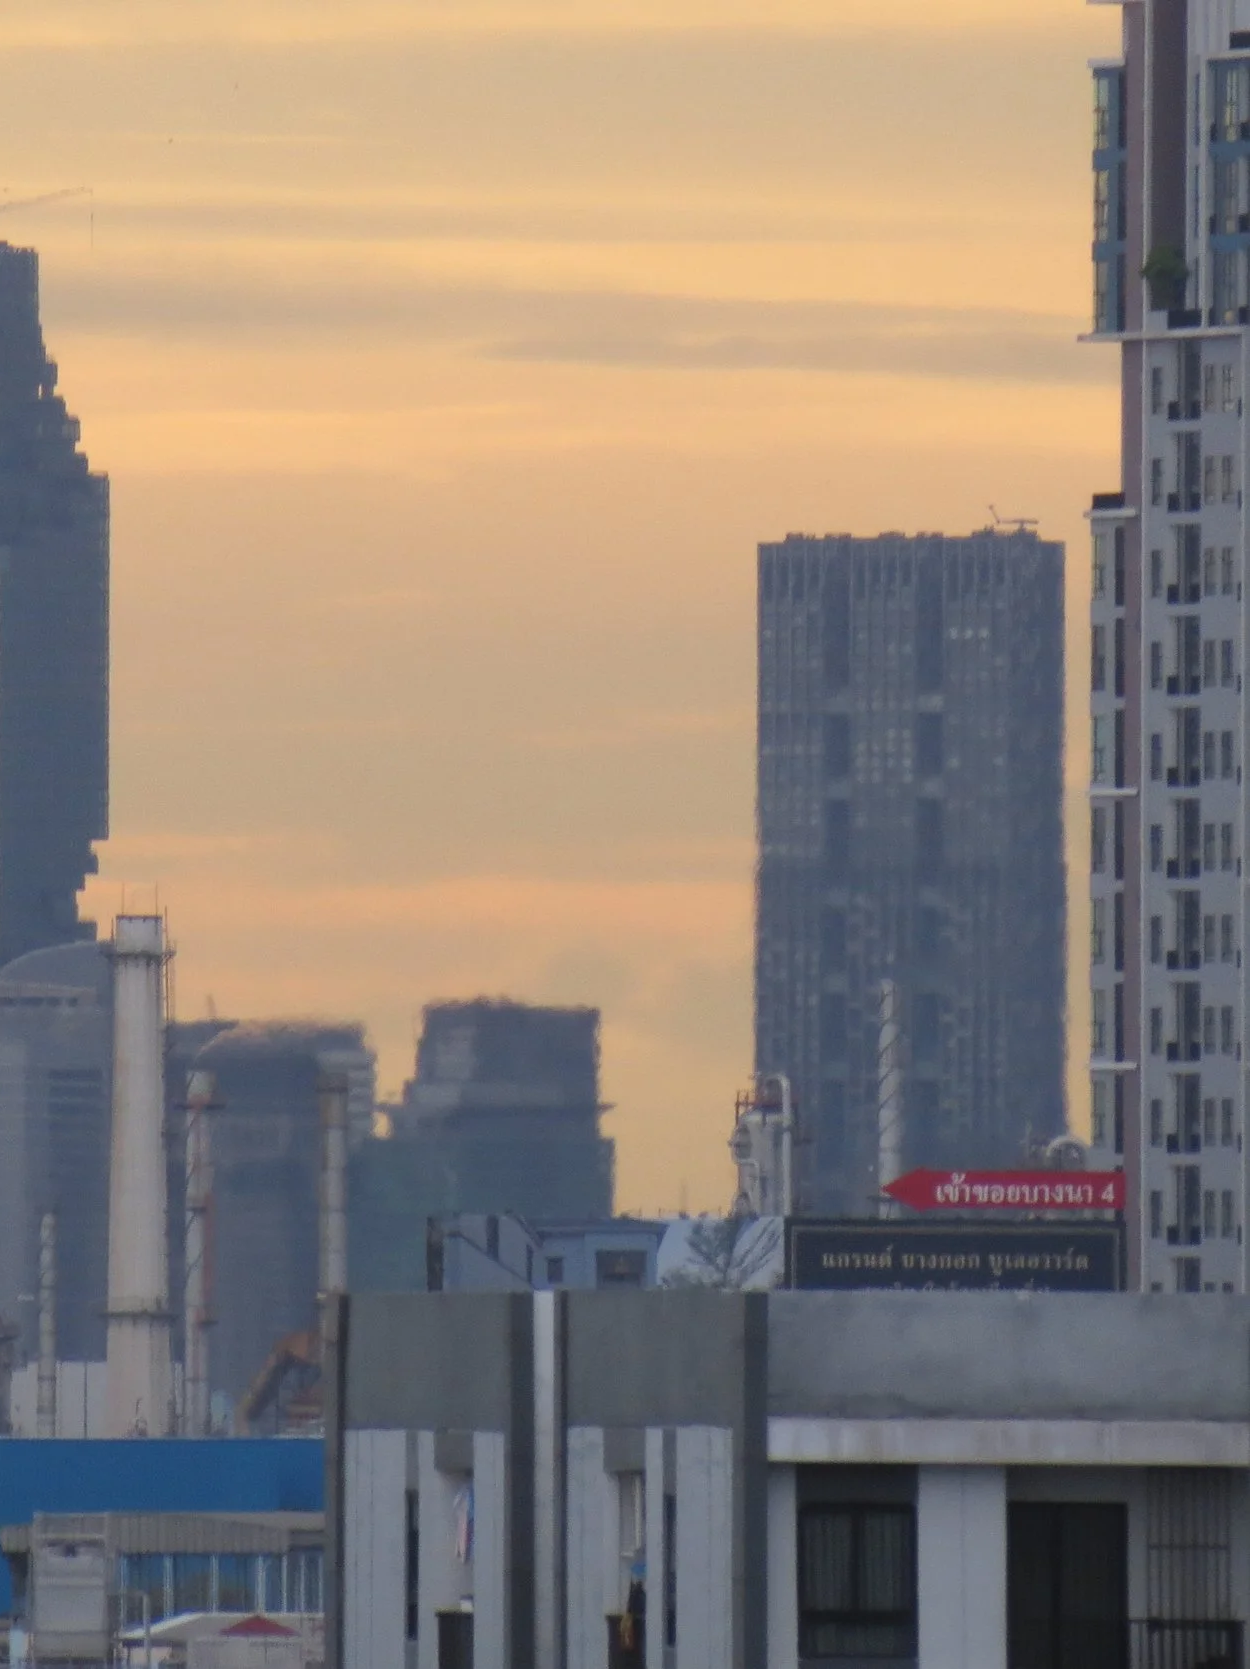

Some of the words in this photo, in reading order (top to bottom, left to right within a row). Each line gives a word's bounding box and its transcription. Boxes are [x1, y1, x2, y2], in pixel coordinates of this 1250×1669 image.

[935, 1171, 1093, 1204] เข้าซอยบางนา
[1100, 1182, 1115, 1203] 4
[902, 1252, 980, 1269] บางกอก
